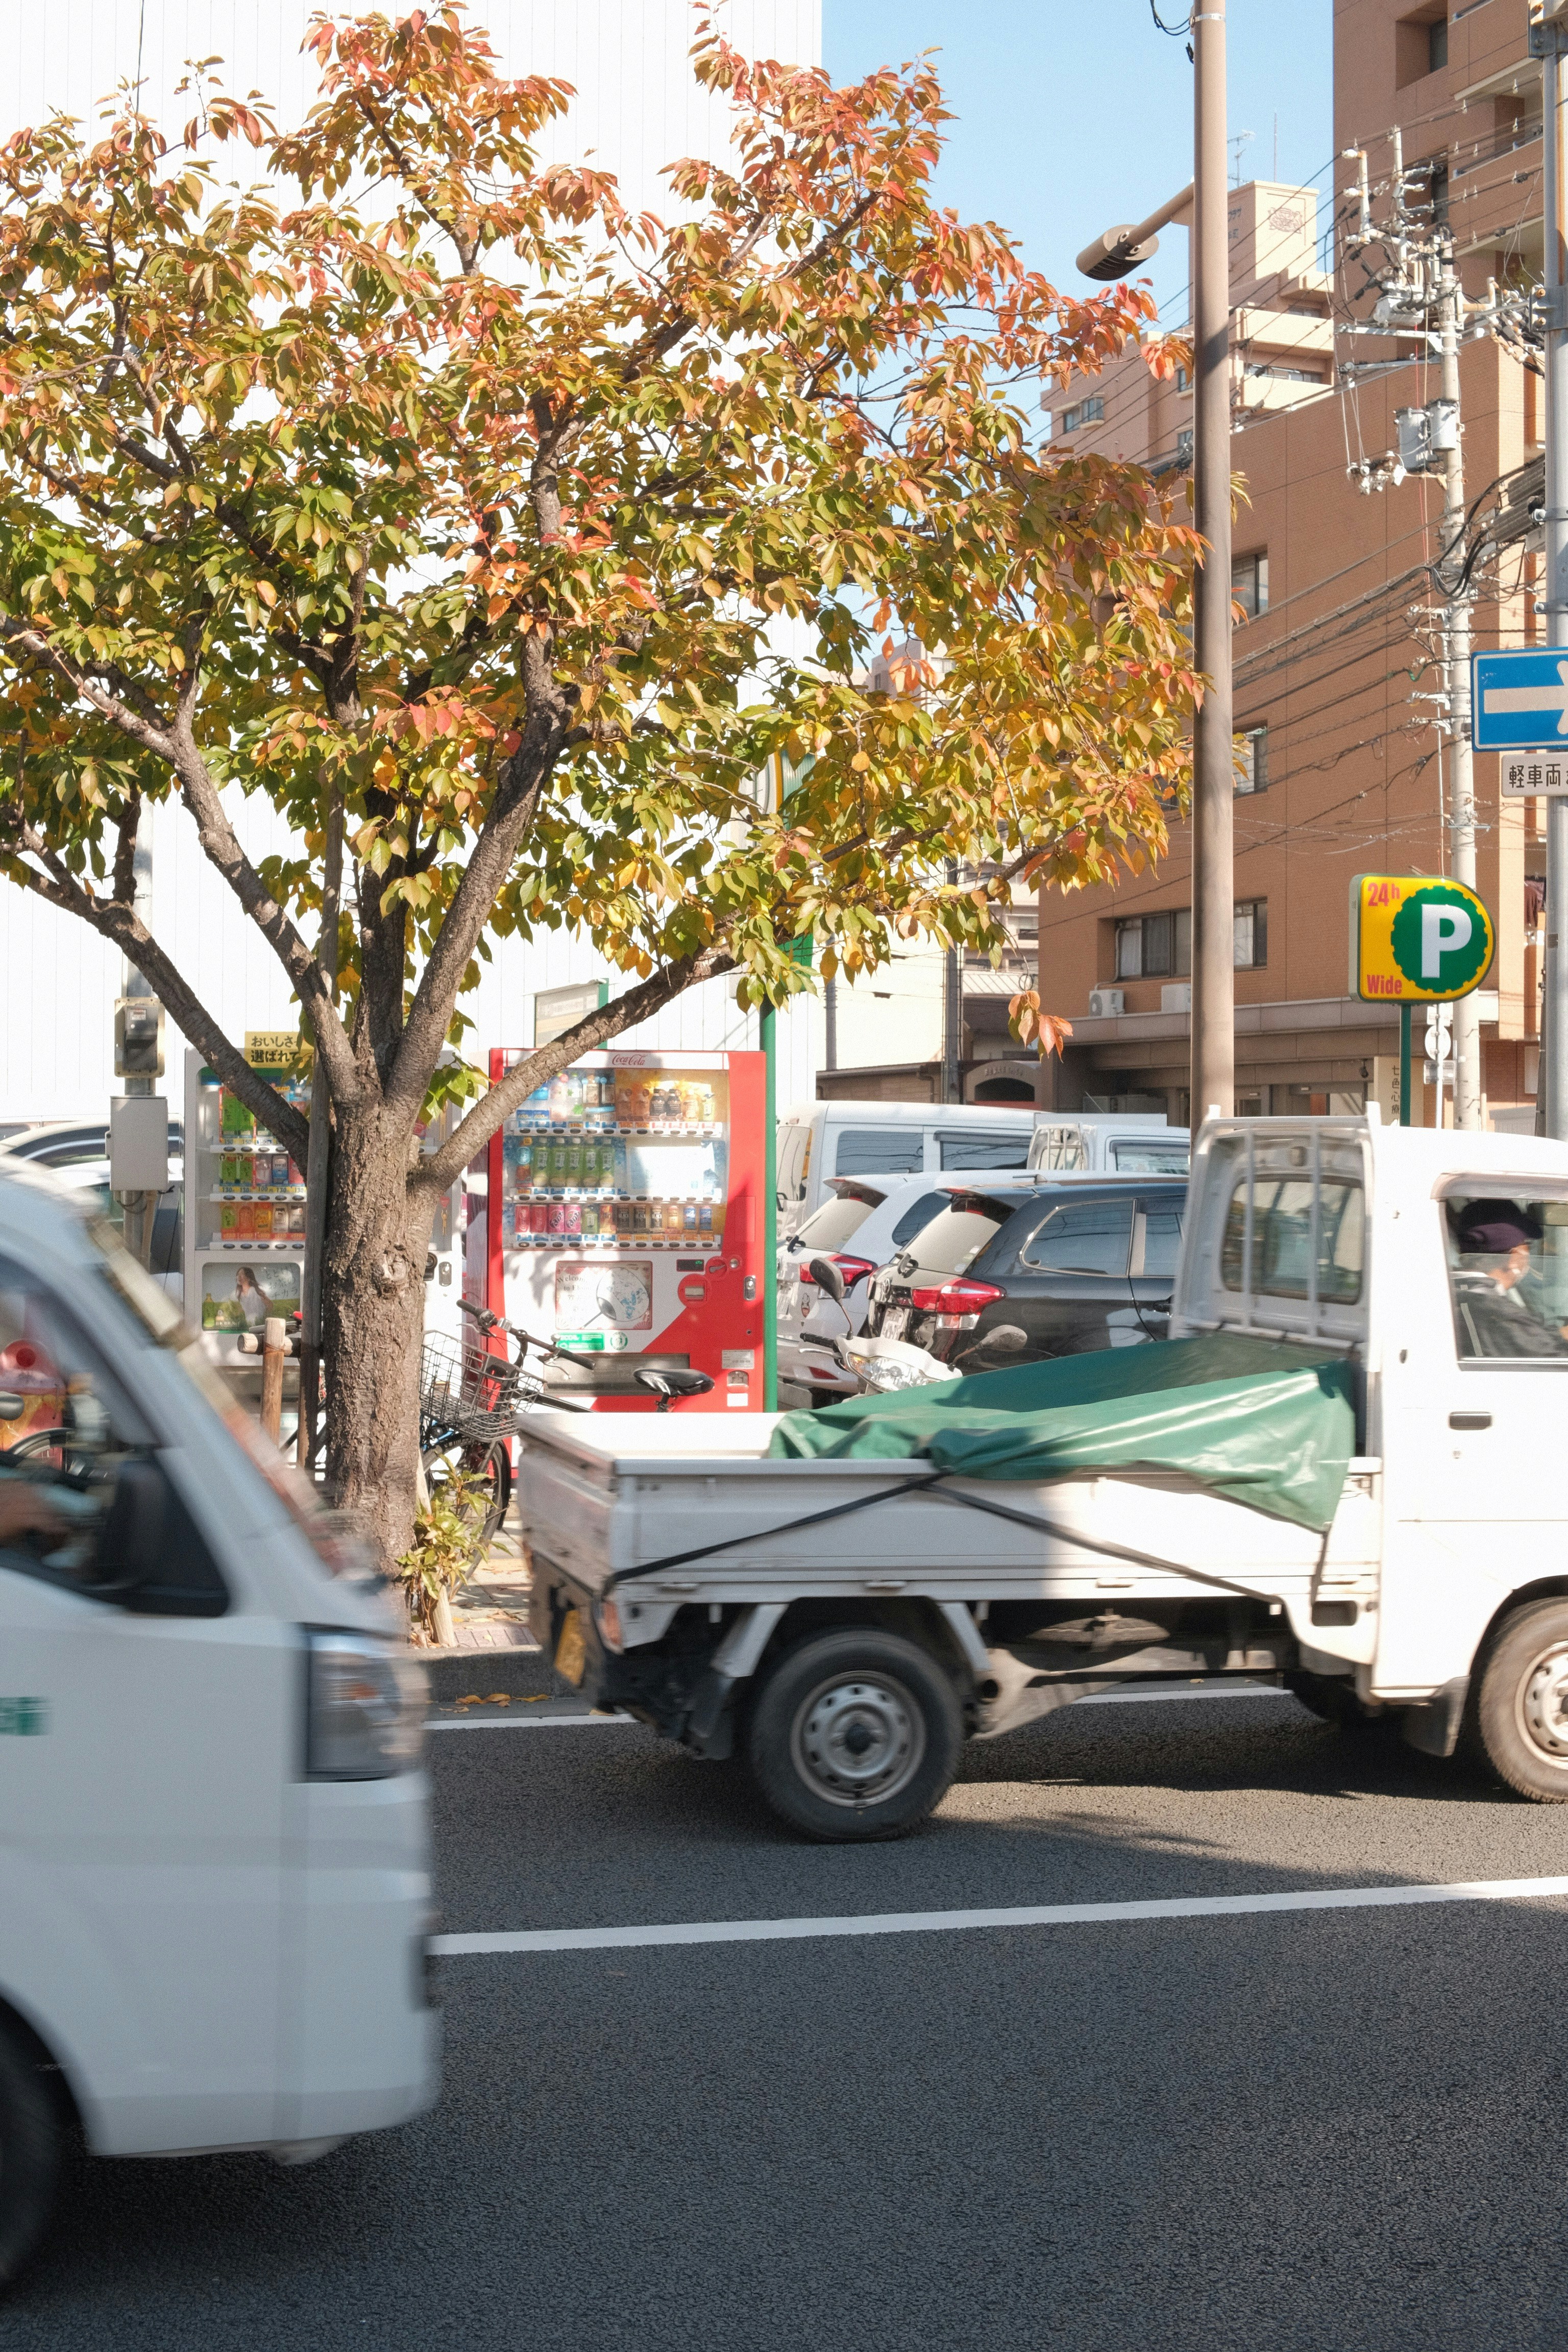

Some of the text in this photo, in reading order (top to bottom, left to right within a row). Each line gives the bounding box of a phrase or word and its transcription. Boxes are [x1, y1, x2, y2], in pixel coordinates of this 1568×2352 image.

[1509, 764, 1568, 788] 軽車両
[1368, 883, 1400, 906] 24h
[1422, 904, 1472, 978] P
[1367, 974, 1402, 994] Wide
[251, 1036, 298, 1048] おいしさ
[612, 1054, 647, 1065] Coca-Cola
[556, 1275, 587, 1283] Welcom
